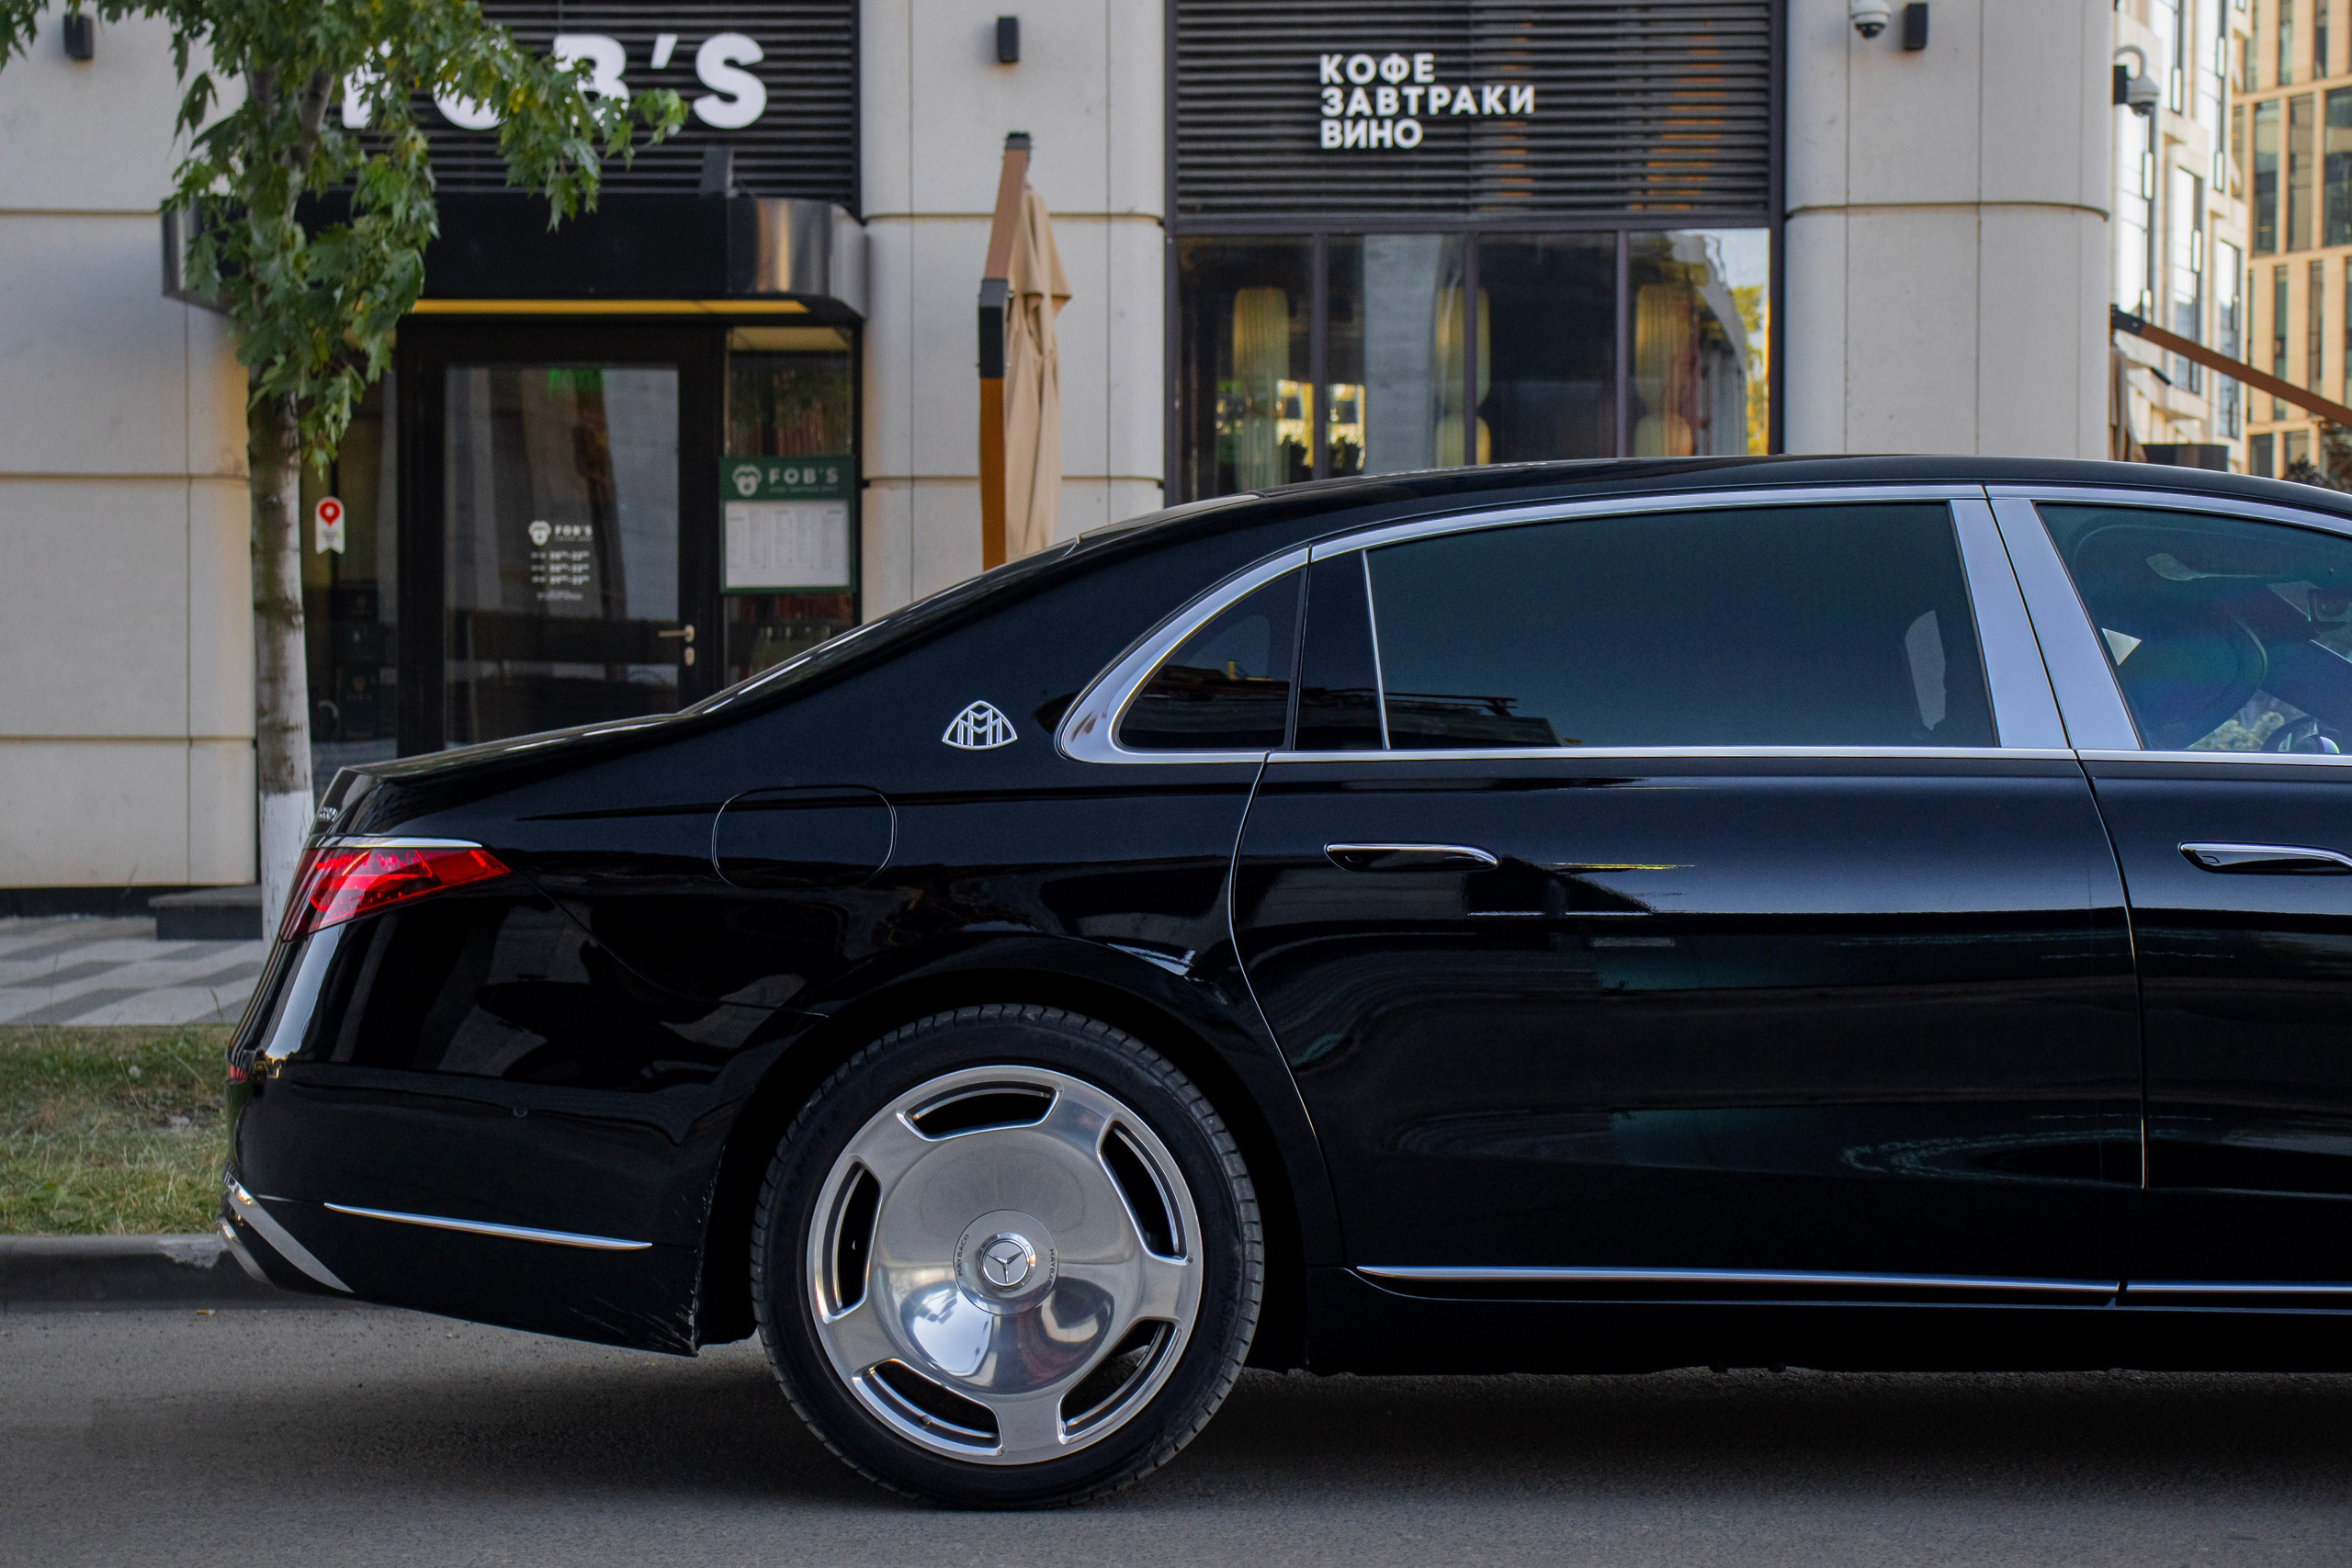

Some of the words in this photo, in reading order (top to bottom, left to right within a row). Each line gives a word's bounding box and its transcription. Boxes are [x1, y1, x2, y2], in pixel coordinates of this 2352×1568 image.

[1319, 53, 1435, 85] КОФЕ
[1320, 85, 1535, 117] ЗАВТРАКИ
[1320, 118, 1423, 149] ВИНО
[768, 467, 839, 485] FOB'S
[956, 1234, 970, 1277] MAYBACH
